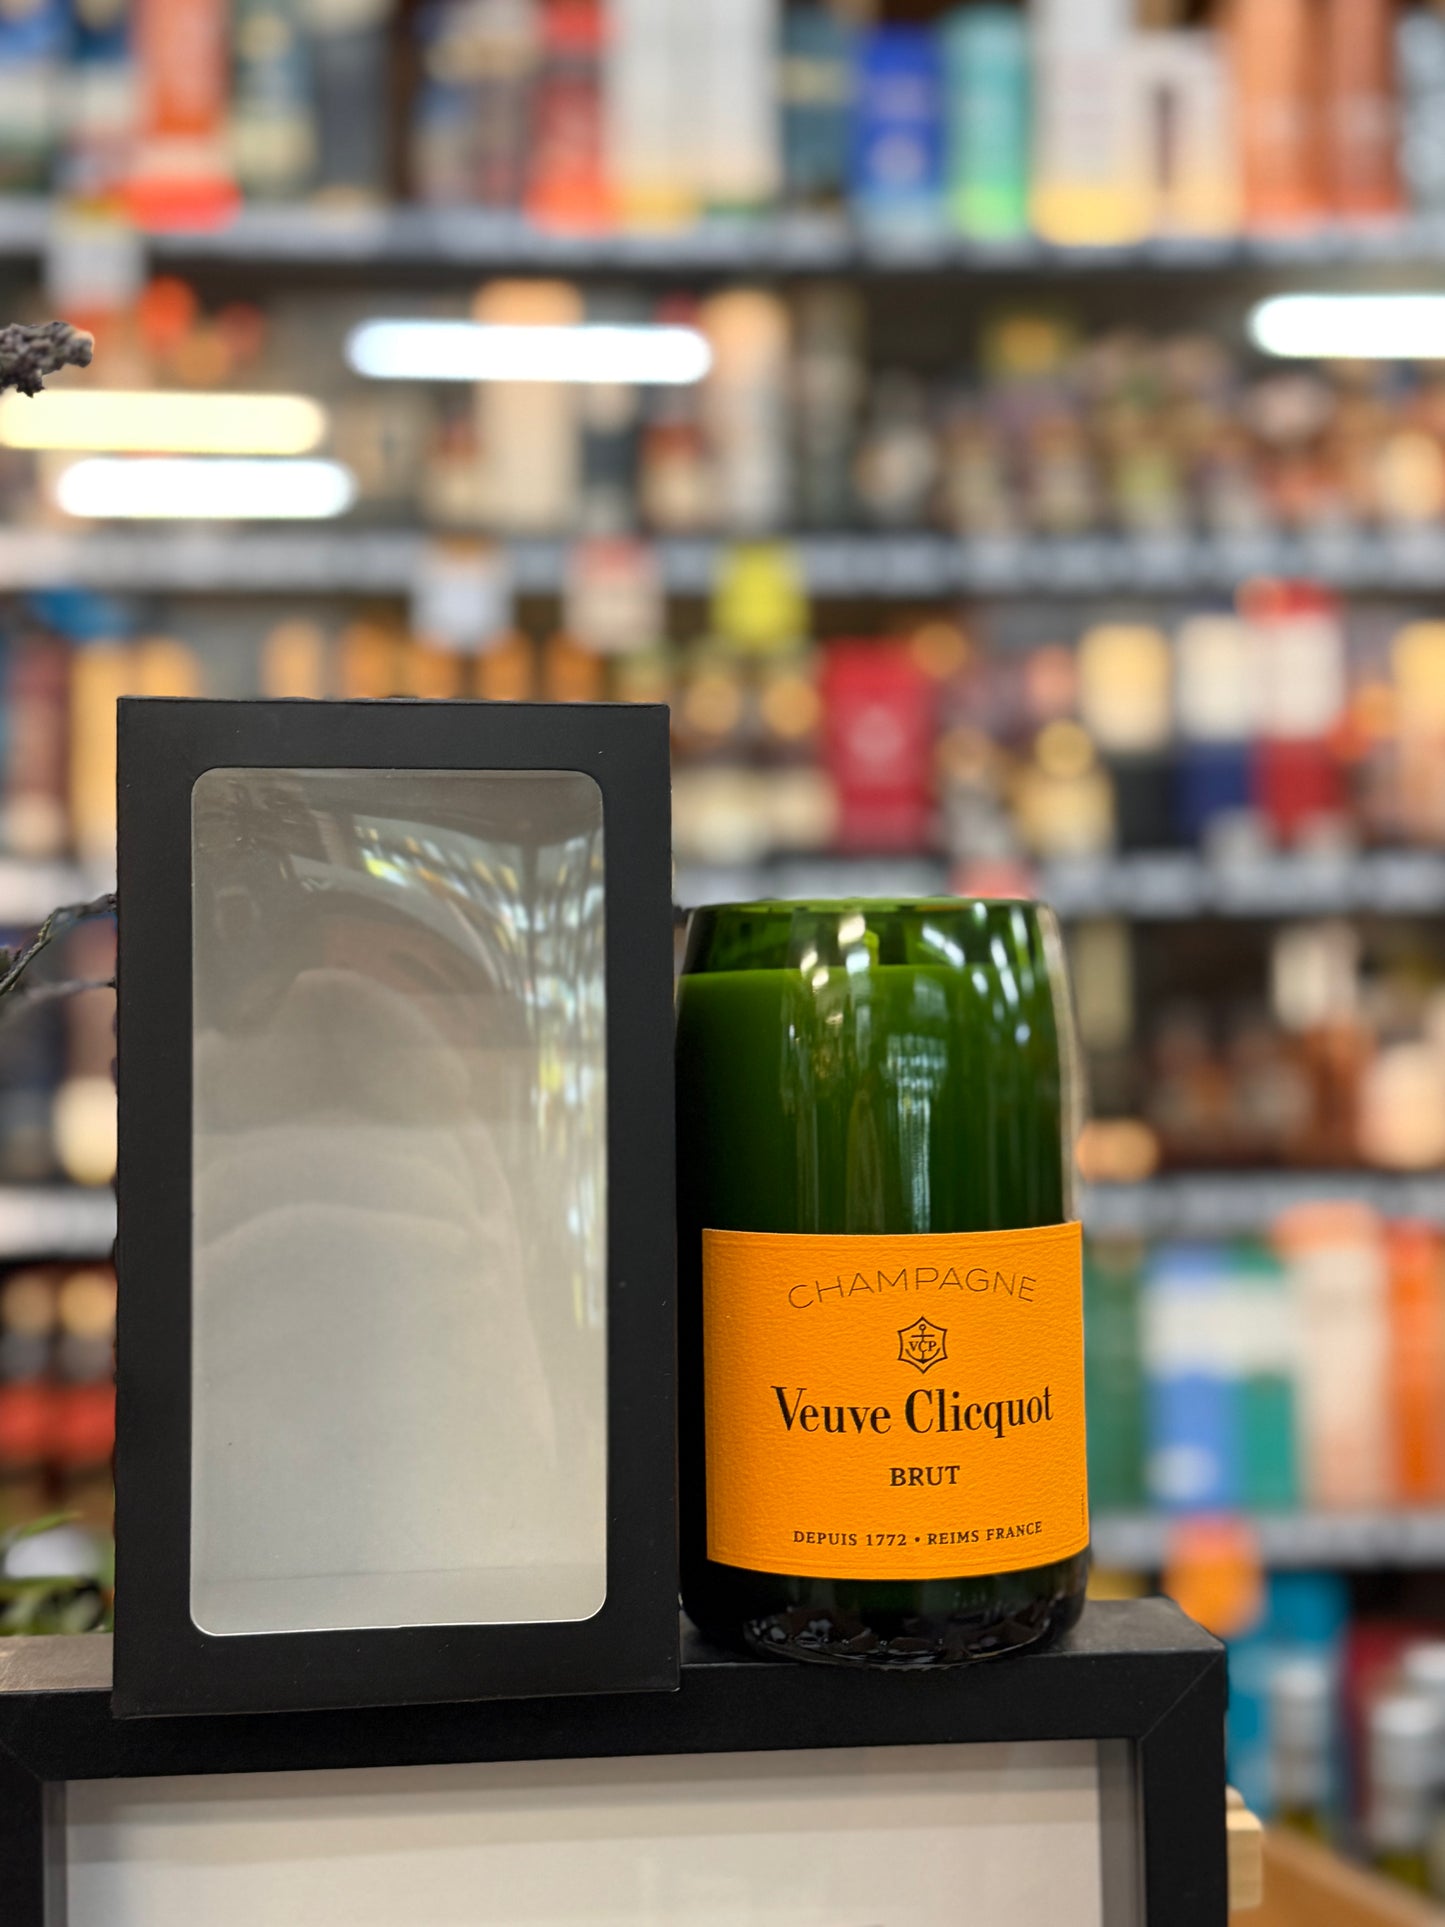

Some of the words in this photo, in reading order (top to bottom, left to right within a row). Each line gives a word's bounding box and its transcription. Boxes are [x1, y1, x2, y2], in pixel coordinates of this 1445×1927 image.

[788, 1267, 1036, 1309] CHAMPAGNE
[771, 1386, 891, 1434] Veuve
[905, 1386, 1053, 1439] Clicquot
[889, 1465, 960, 1487] BRUT
[793, 1530, 858, 1547] DEPUIS
[866, 1533, 907, 1547] 1772
[927, 1529, 980, 1546] REIMS
[986, 1520, 1042, 1541] FRANCE
